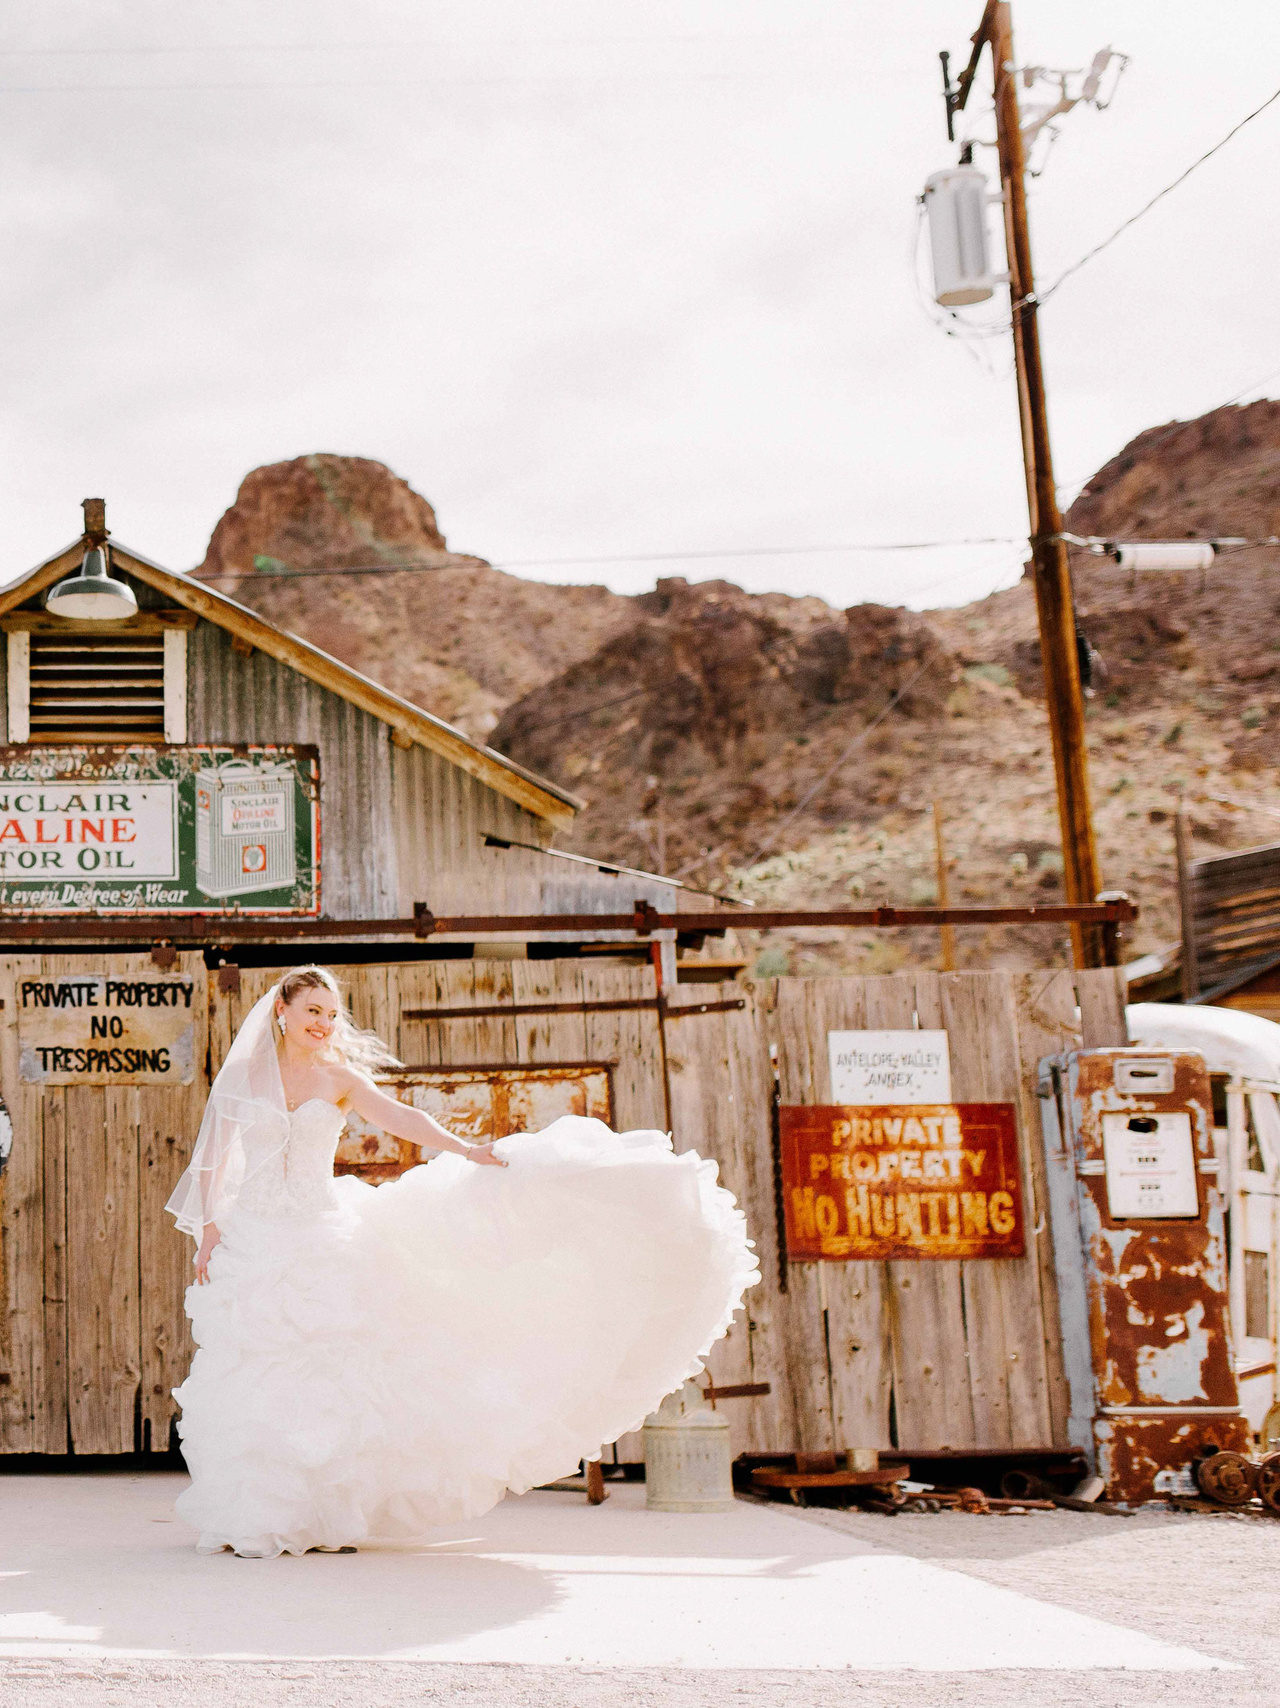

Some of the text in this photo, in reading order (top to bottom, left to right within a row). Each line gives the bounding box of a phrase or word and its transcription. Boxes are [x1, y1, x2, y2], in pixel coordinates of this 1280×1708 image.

[77, 847, 136, 871] OIL
[11, 889, 59, 907] every
[61, 883, 121, 907] Degree
[123, 883, 144, 907] of
[145, 882, 189, 904] Wear
[22, 981, 194, 1008] PRIVATE PROPERTY
[91, 1015, 123, 1039] NO
[35, 1046, 171, 1073] TRESPASSING
[836, 1051, 942, 1068] ANTELOPE VALLEY
[868, 1073, 915, 1088] ANNEX
[831, 1115, 963, 1147] PRIVATE
[810, 1150, 987, 1180] PROPERTY
[792, 1184, 1016, 1238] NO HUNTING
